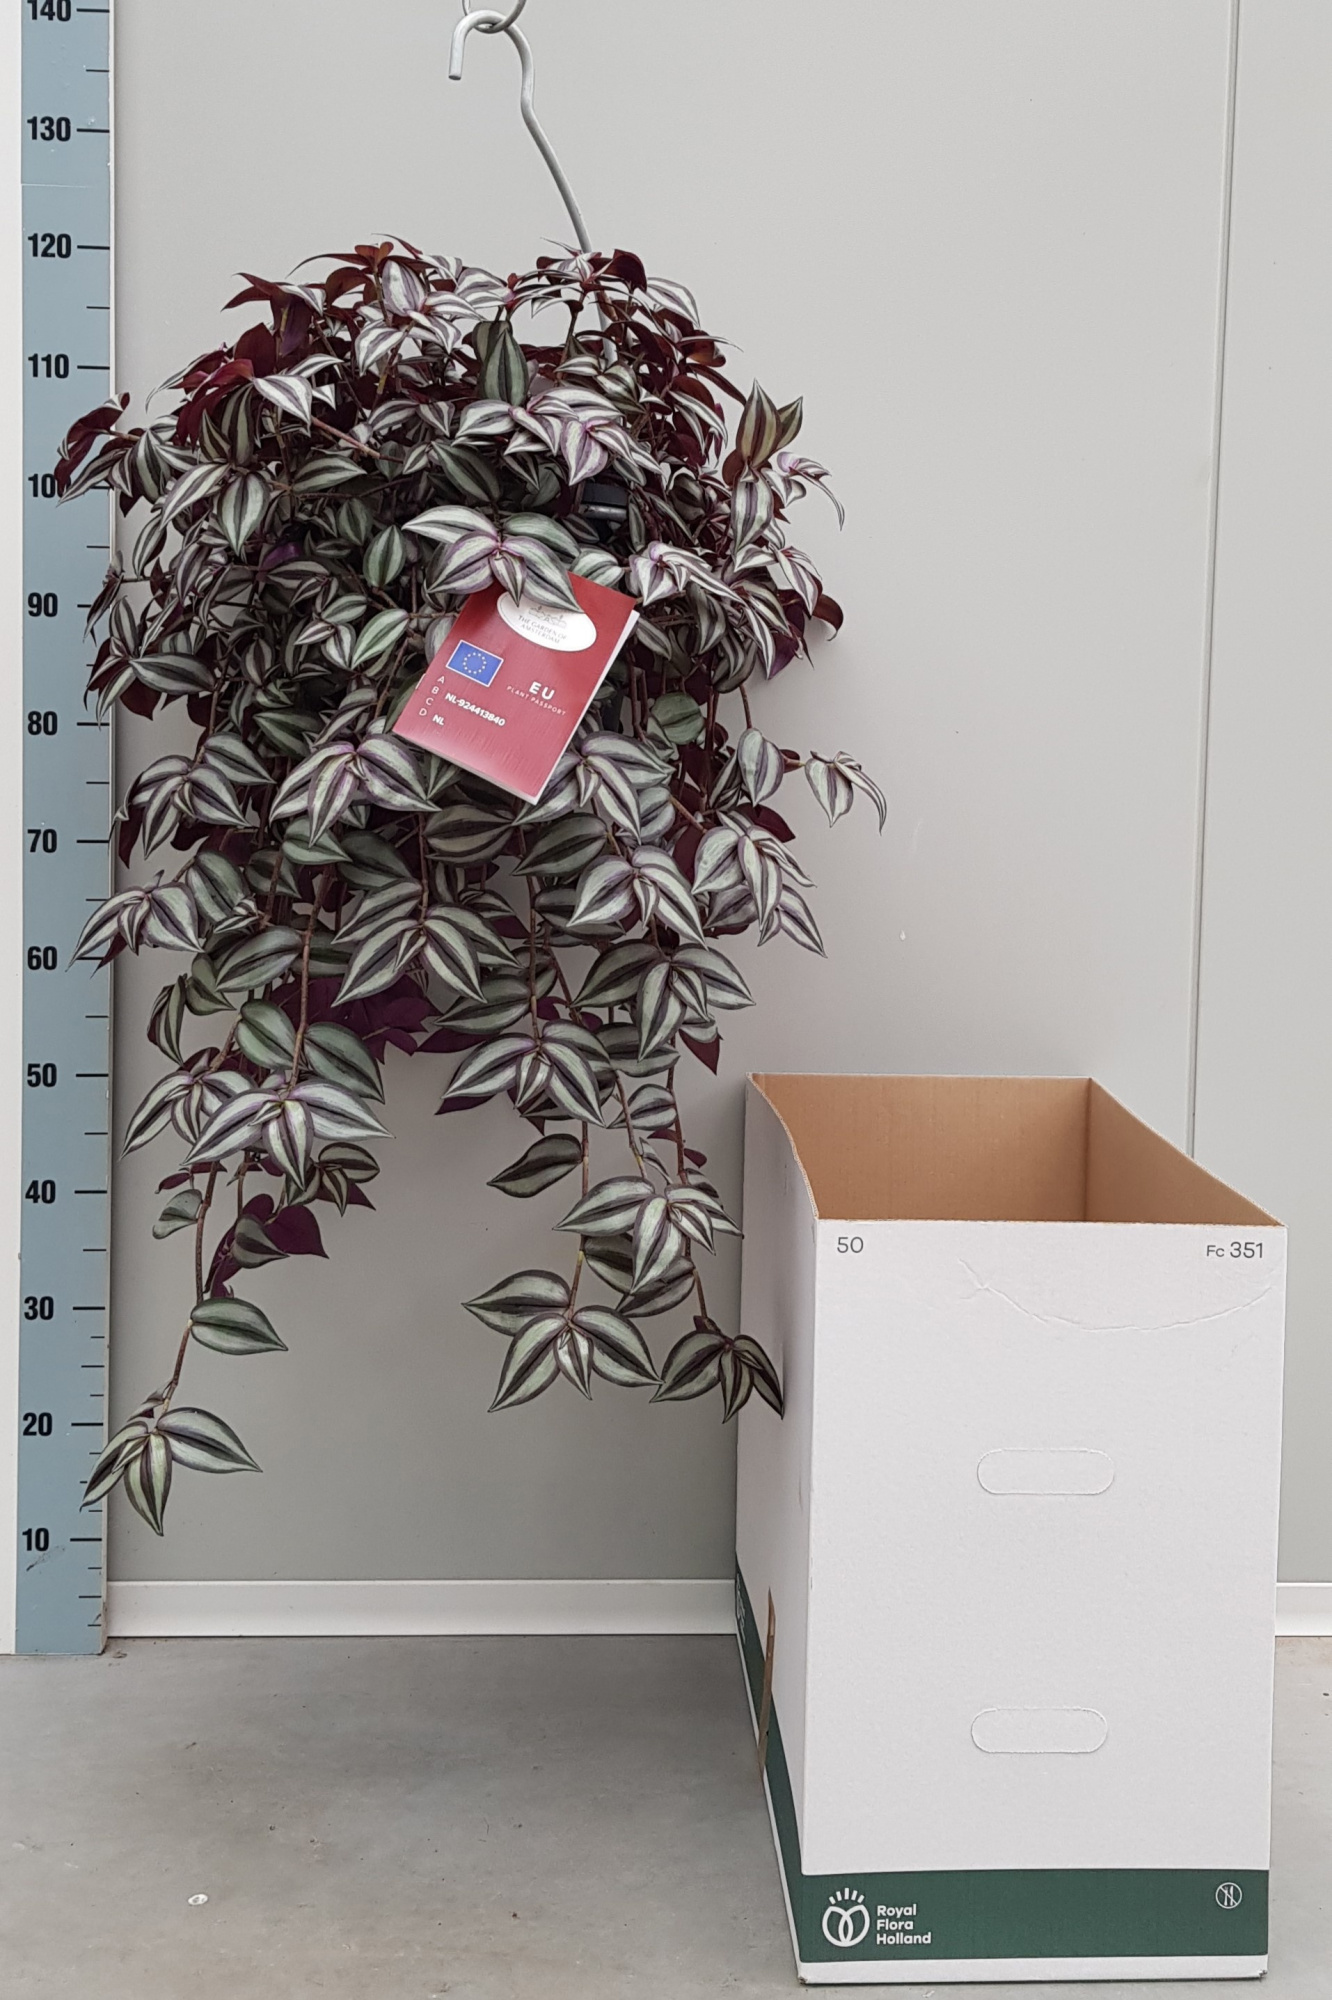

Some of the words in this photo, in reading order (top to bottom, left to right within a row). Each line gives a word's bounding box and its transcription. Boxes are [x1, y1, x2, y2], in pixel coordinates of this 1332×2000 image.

[27, 0, 71, 22] 140
[27, 117, 71, 141] 130
[27, 233, 71, 258] 120
[27, 354, 69, 378] 110
[28, 473, 66, 498] 10
[28, 593, 58, 617] 90
[437, 676, 445, 684] A
[425, 697, 434, 706] C
[431, 686, 440, 694] B
[445, 692, 506, 726] NL-924413840
[507, 685, 530, 699] PLANT
[531, 697, 566, 716] PASSPORT
[28, 711, 57, 735] 80
[419, 708, 428, 716] D
[432, 714, 445, 726] NL
[28, 829, 57, 853] 70
[28, 946, 57, 970] 60
[27, 1063, 57, 1087] 50
[25, 1180, 56, 1204] 40
[837, 1236, 864, 1254] 50
[1206, 1245, 1225, 1258] Fc
[1230, 1242, 1263, 1259] 351
[24, 1296, 54, 1320] 30
[22, 1412, 52, 1436] 20
[22, 1528, 49, 1551] 10
[877, 1904, 917, 1918] Royal
[876, 1919, 914, 1931] Flora
[876, 1932, 931, 1945] Holland
